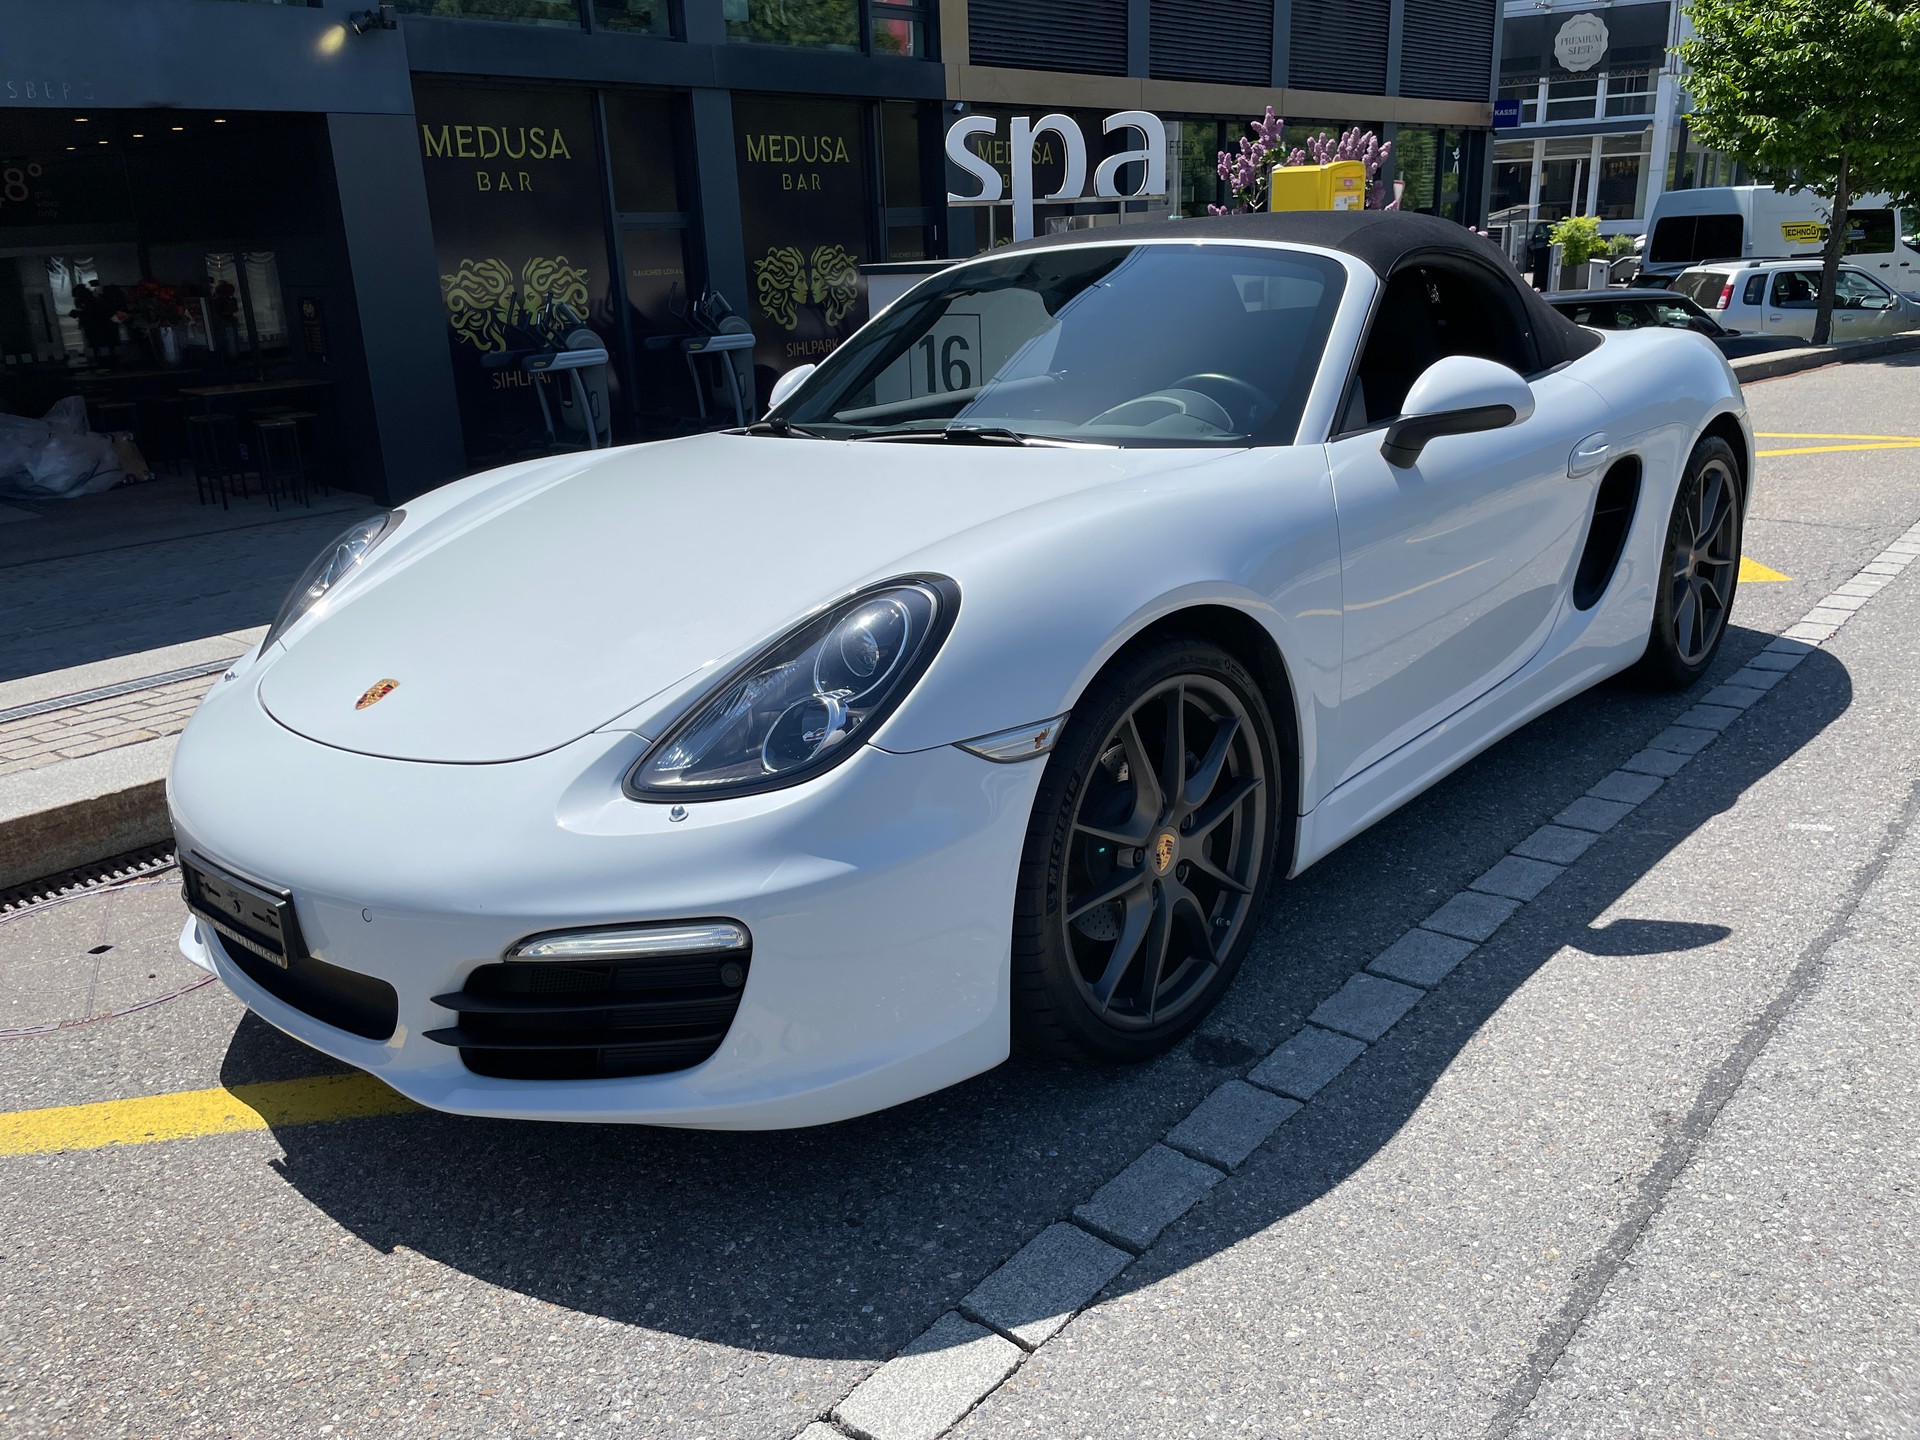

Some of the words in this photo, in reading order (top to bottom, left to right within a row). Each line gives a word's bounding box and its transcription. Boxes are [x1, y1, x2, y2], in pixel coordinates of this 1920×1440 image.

[1560, 34, 1602, 46] PREMIUM
[1567, 45, 1594, 55] SHOP
[1494, 108, 1518, 116] KASSE
[422, 124, 572, 160] MEDUSA
[745, 134, 850, 164] MEDUSA
[977, 140, 1055, 165] MESA
[476, 171, 533, 192] BAR
[782, 173, 822, 191] BAR
[945, 110, 1167, 241] spa
[786, 338, 839, 358] SIHLPARK
[918, 335, 971, 393] 16
[1048, 775, 1080, 886] MICHELIN
